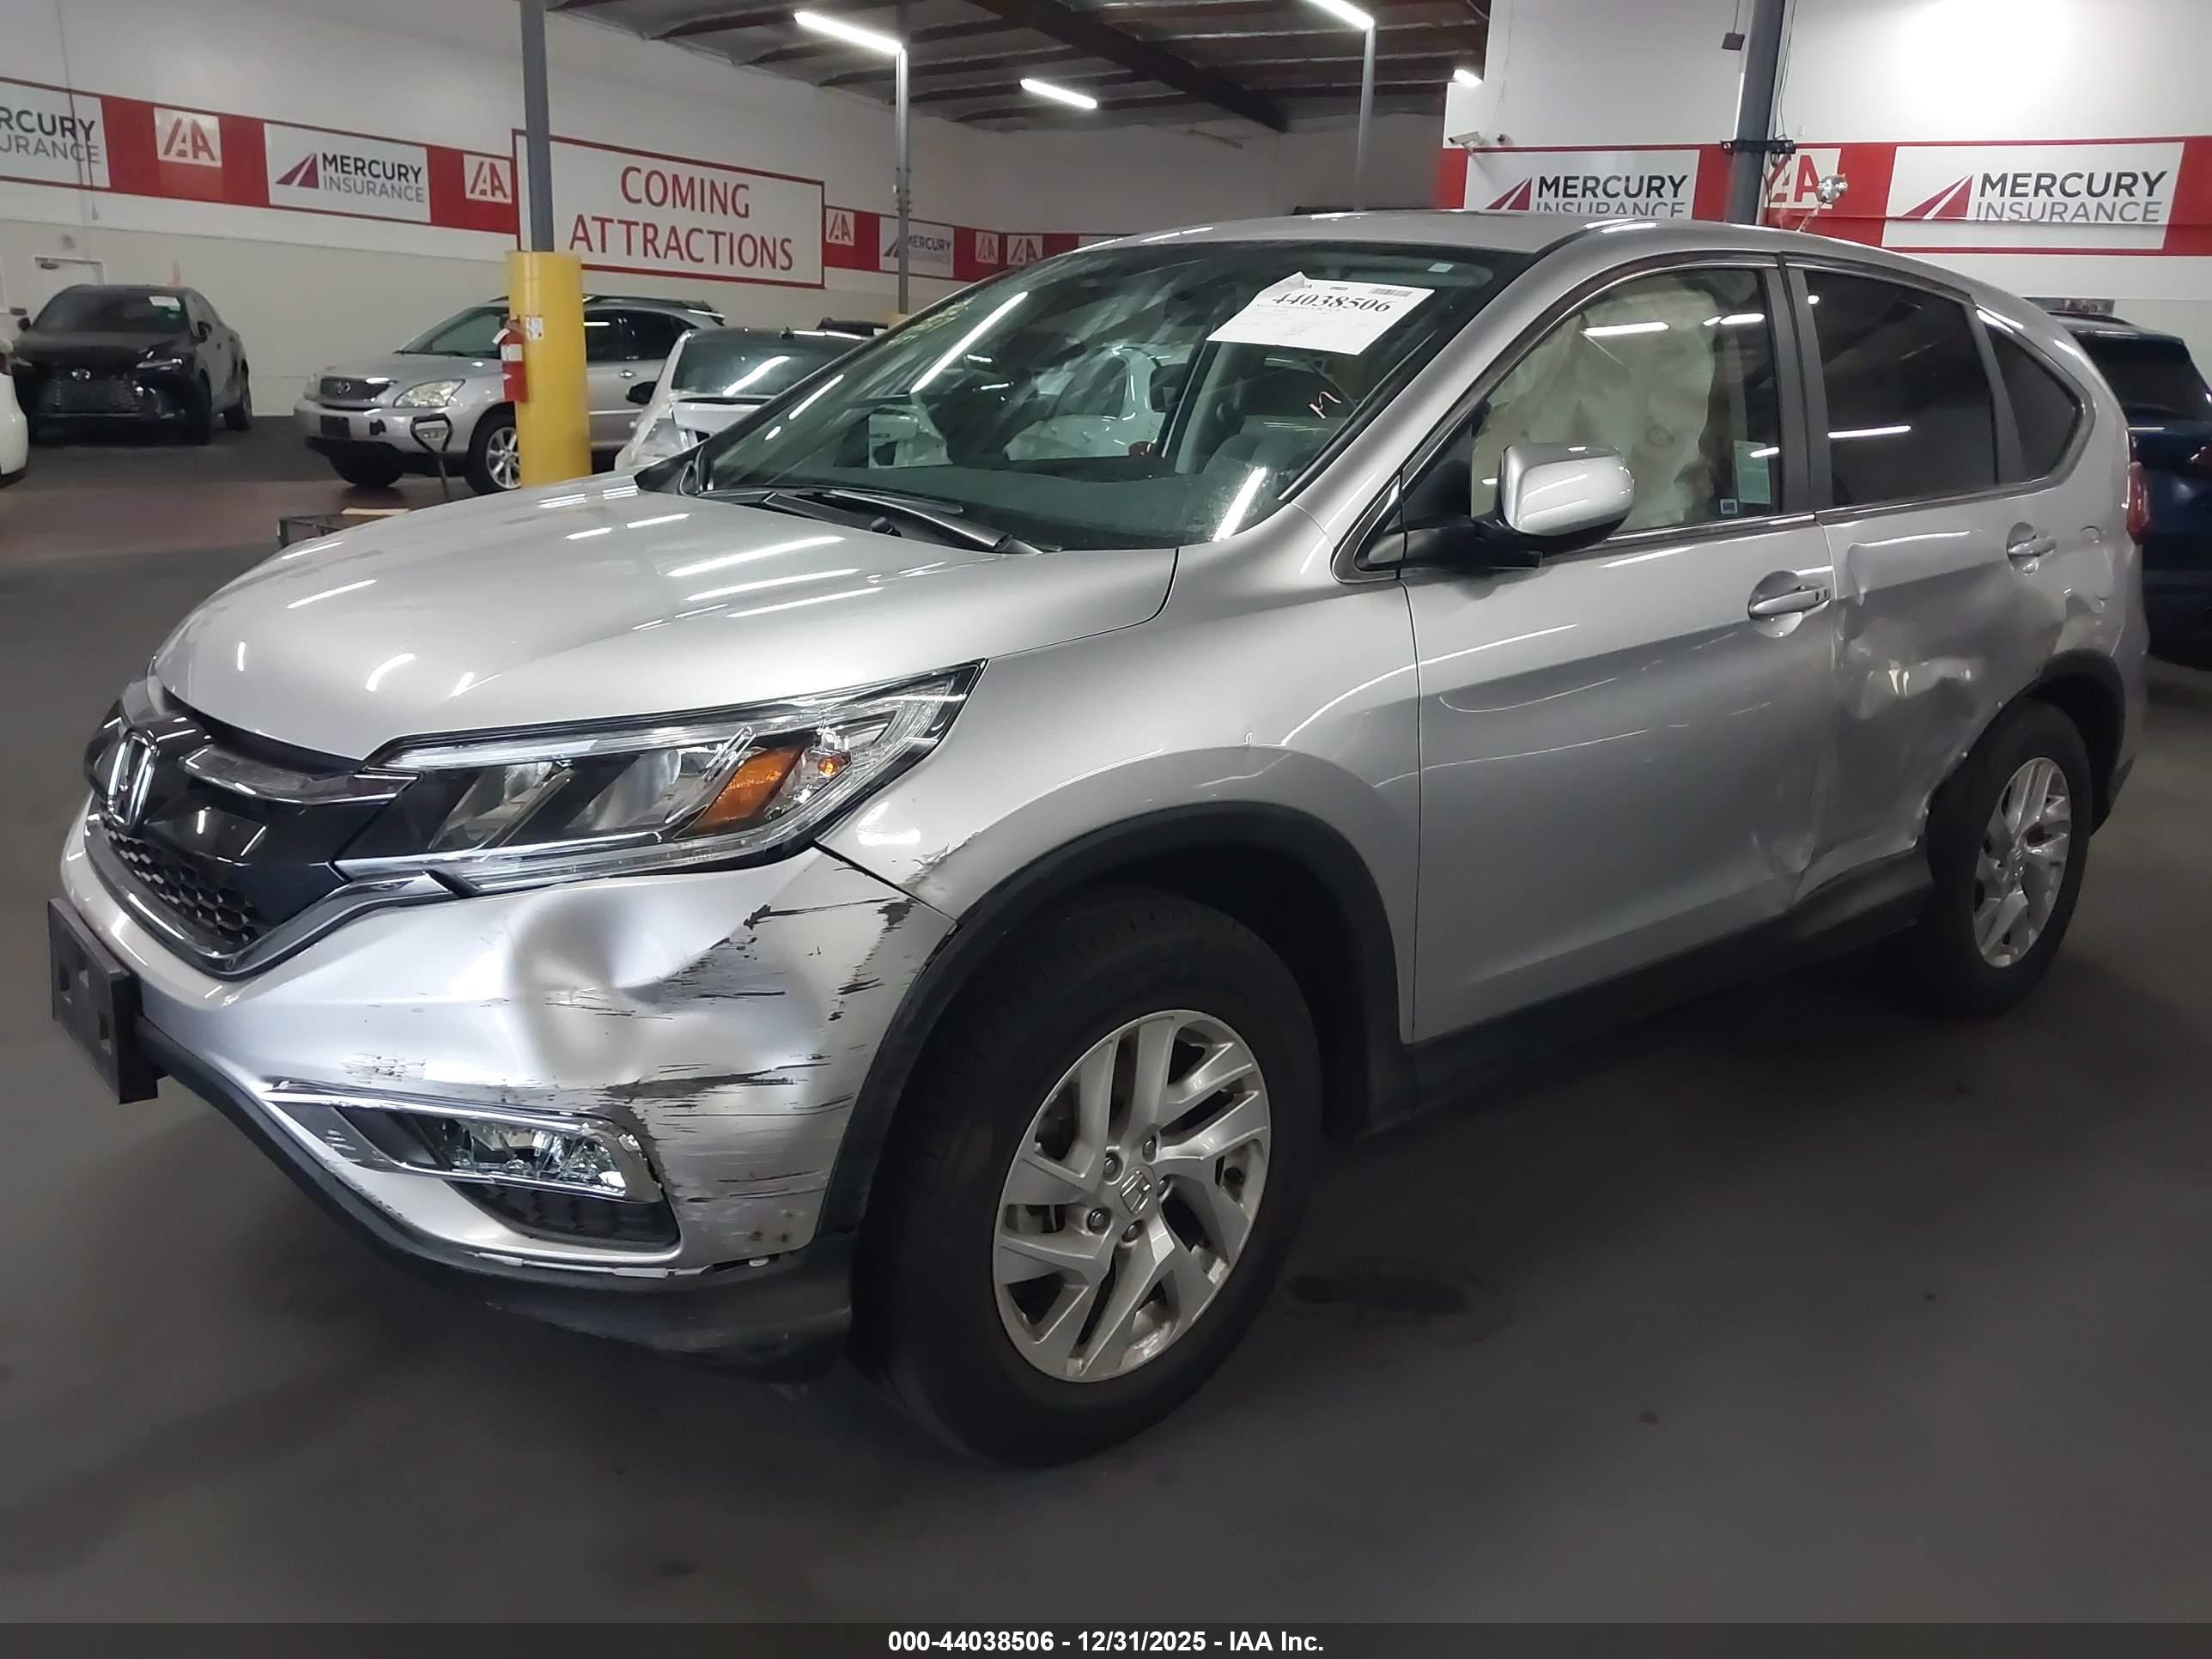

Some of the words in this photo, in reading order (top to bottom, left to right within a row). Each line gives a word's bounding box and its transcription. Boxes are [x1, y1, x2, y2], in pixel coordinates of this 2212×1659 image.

[322, 152, 422, 184] MERCURY
[323, 175, 425, 203] INSURANCE
[620, 166, 750, 219] COMING
[1537, 174, 1689, 198] MERCURY
[1978, 170, 2168, 198] MERCURY
[1976, 201, 2163, 223] INSURANCE
[569, 214, 793, 271] ATTRACTIONS
[1272, 293, 1397, 313] 44038506
